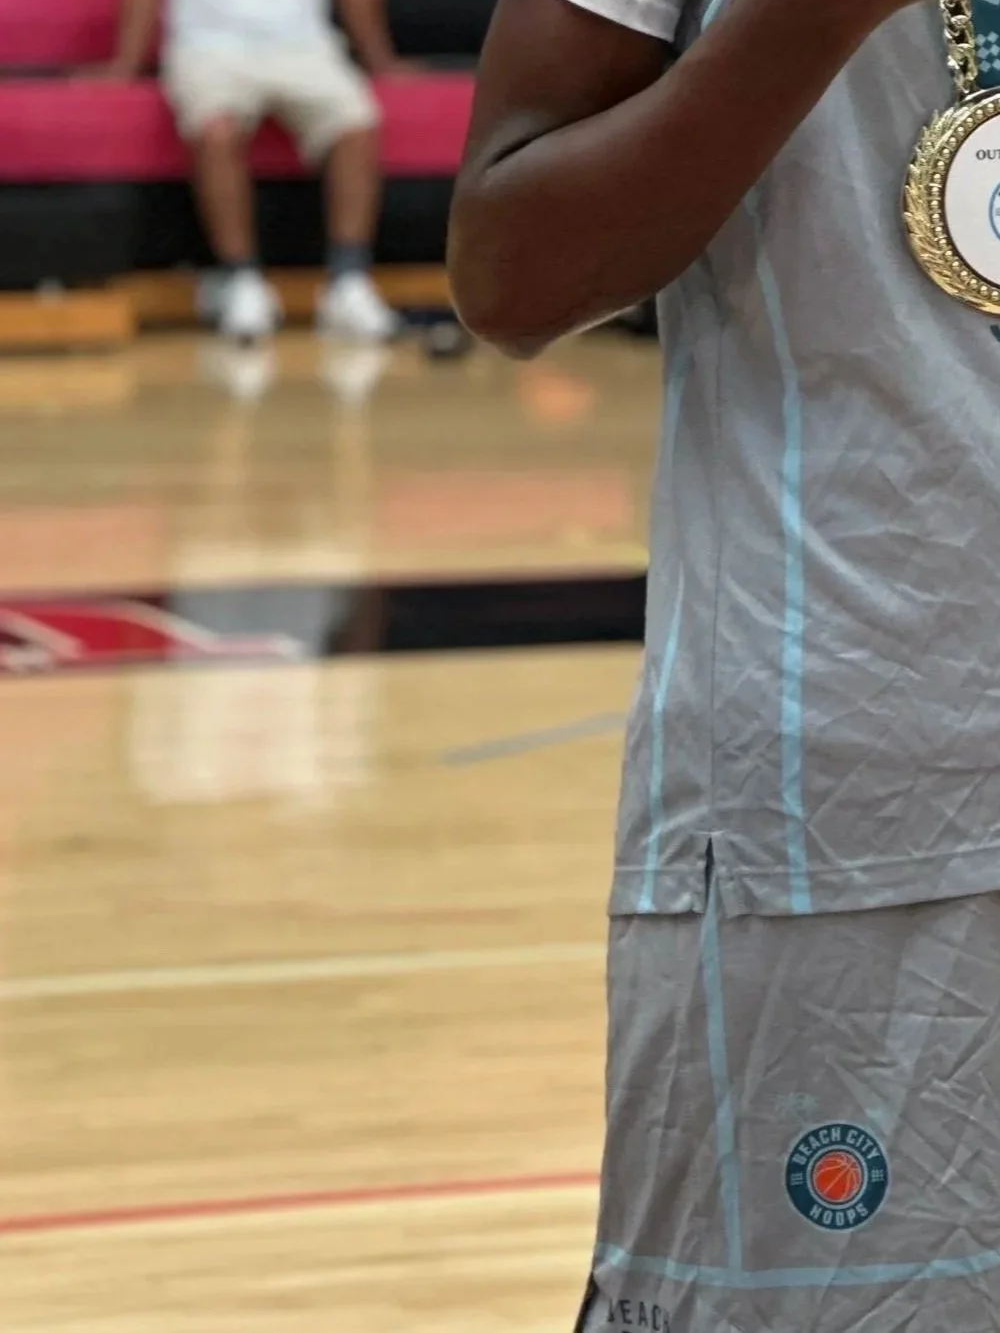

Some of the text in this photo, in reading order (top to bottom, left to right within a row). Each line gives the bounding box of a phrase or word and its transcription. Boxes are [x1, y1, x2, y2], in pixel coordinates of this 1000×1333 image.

[791, 1127, 881, 1166] BEACH CITY
[810, 1202, 869, 1227] HOOPS
